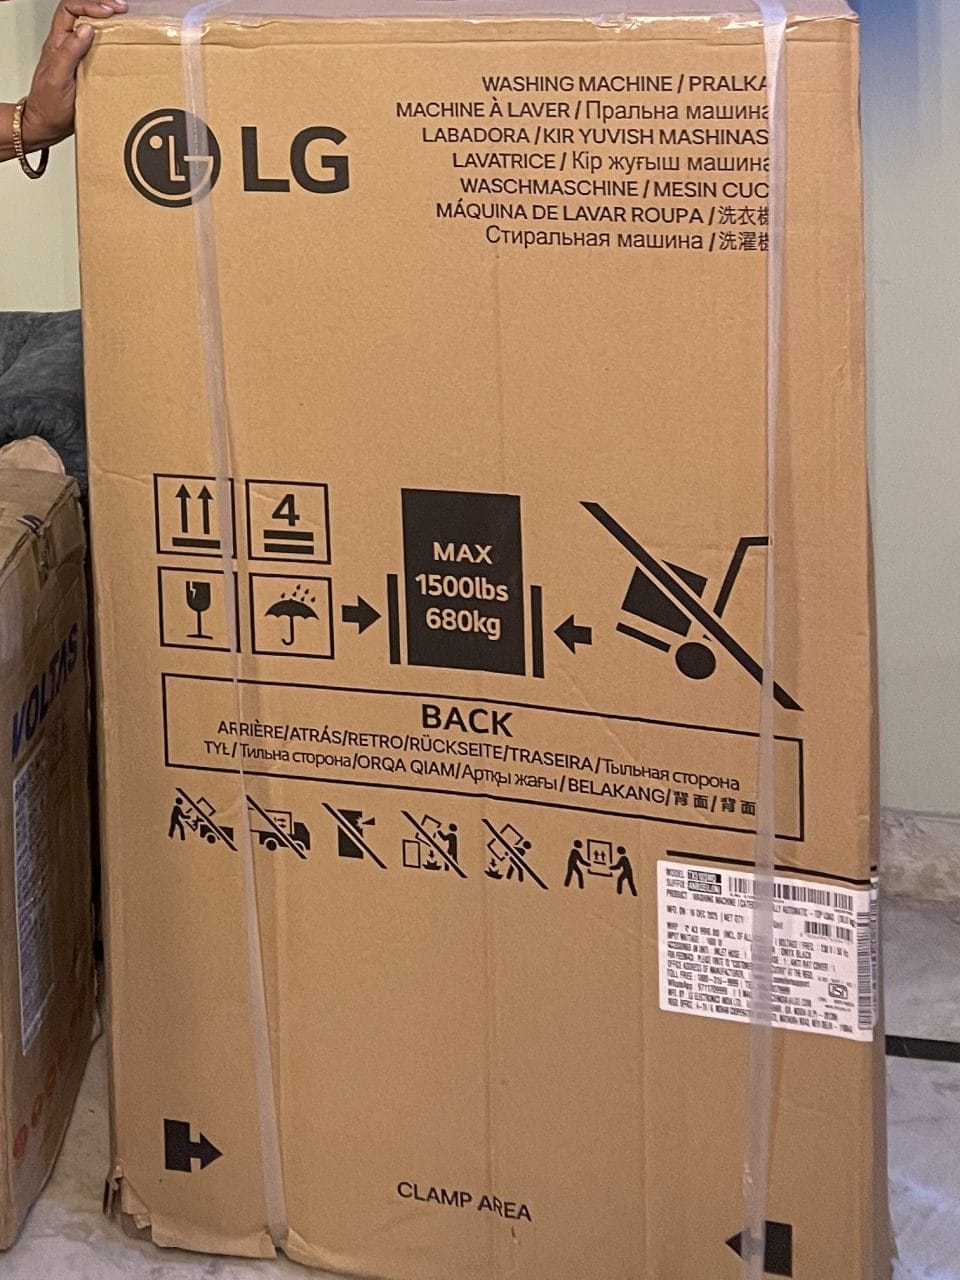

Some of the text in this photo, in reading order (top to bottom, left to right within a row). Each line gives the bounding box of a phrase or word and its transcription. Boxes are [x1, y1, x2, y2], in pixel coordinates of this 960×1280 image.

[482, 75, 574, 92] WASHING
[579, 75, 672, 92] MACHINE
[396, 102, 485, 118] MACHINE
[508, 102, 570, 118] LAVER
[422, 127, 530, 143] LABADORA
[578, 128, 654, 144] YUVISH
[659, 129, 769, 145] MASHINAS
[240, 125, 350, 194] LG
[452, 152, 555, 169] LAVATRICE
[460, 178, 638, 197] WASCHMASCHINE
[653, 181, 717, 198] MESIN
[722, 182, 769, 199] CUC
[436, 198, 527, 219] MÁQUINA
[532, 205, 558, 220] DE
[563, 205, 626, 222] LAVAR
[631, 206, 704, 224] ROUPA
[486, 225, 610, 249] Стиральная
[618, 233, 703, 249] машина
[272, 494, 300, 526] 4
[433, 541, 493, 565] MAX
[414, 573, 509, 602] 1500lbs
[425, 607, 501, 641] 680kg
[422, 703, 514, 737] BACK
[397, 1181, 532, 1222] CLAMP AREA
